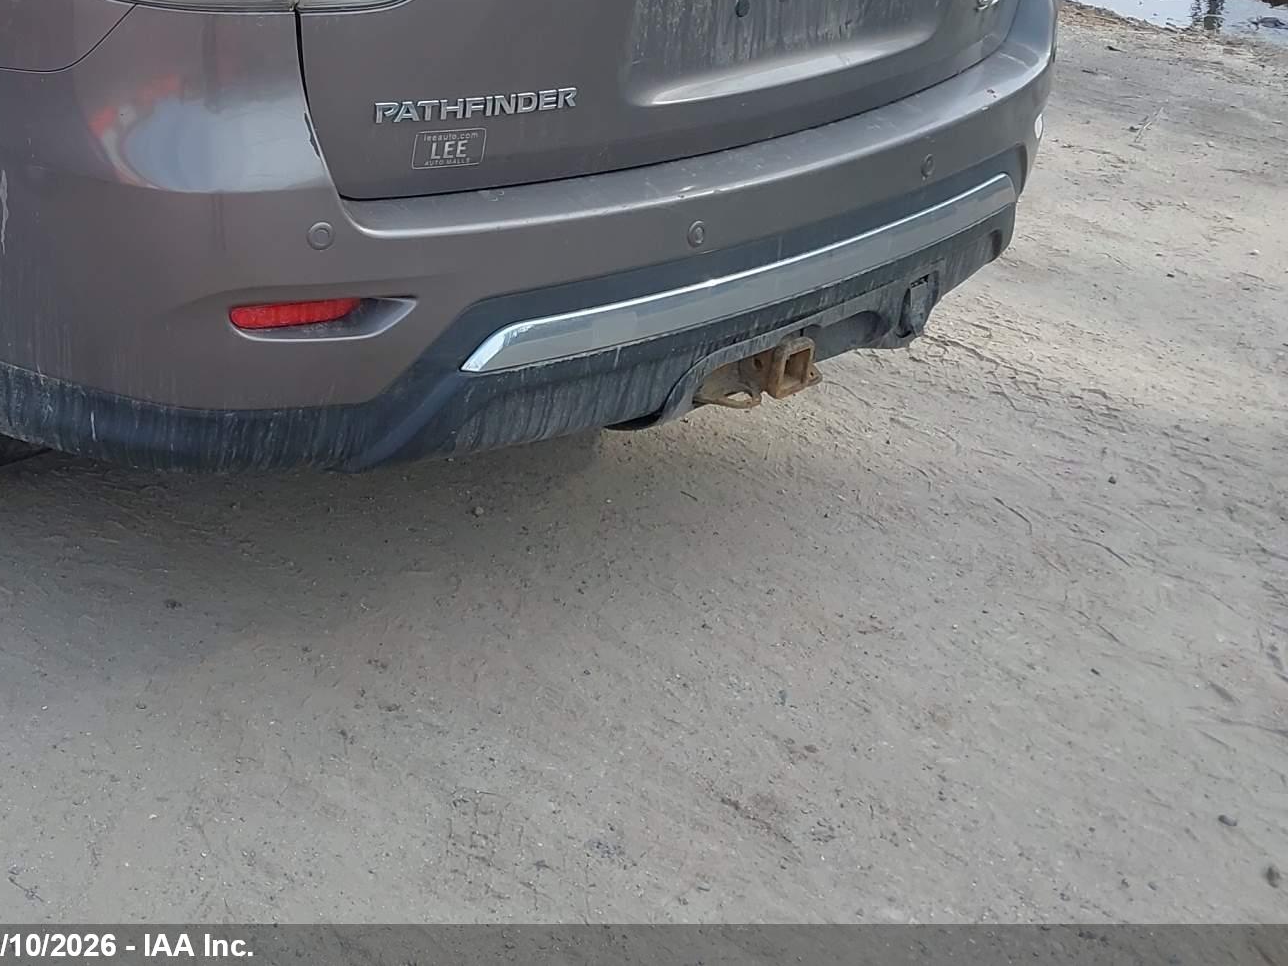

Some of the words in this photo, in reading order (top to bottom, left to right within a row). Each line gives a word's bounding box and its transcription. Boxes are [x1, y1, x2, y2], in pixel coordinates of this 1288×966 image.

[373, 87, 578, 124] PATHFINDER
[423, 132, 478, 142] leeauto.com
[430, 139, 469, 160] LEE
